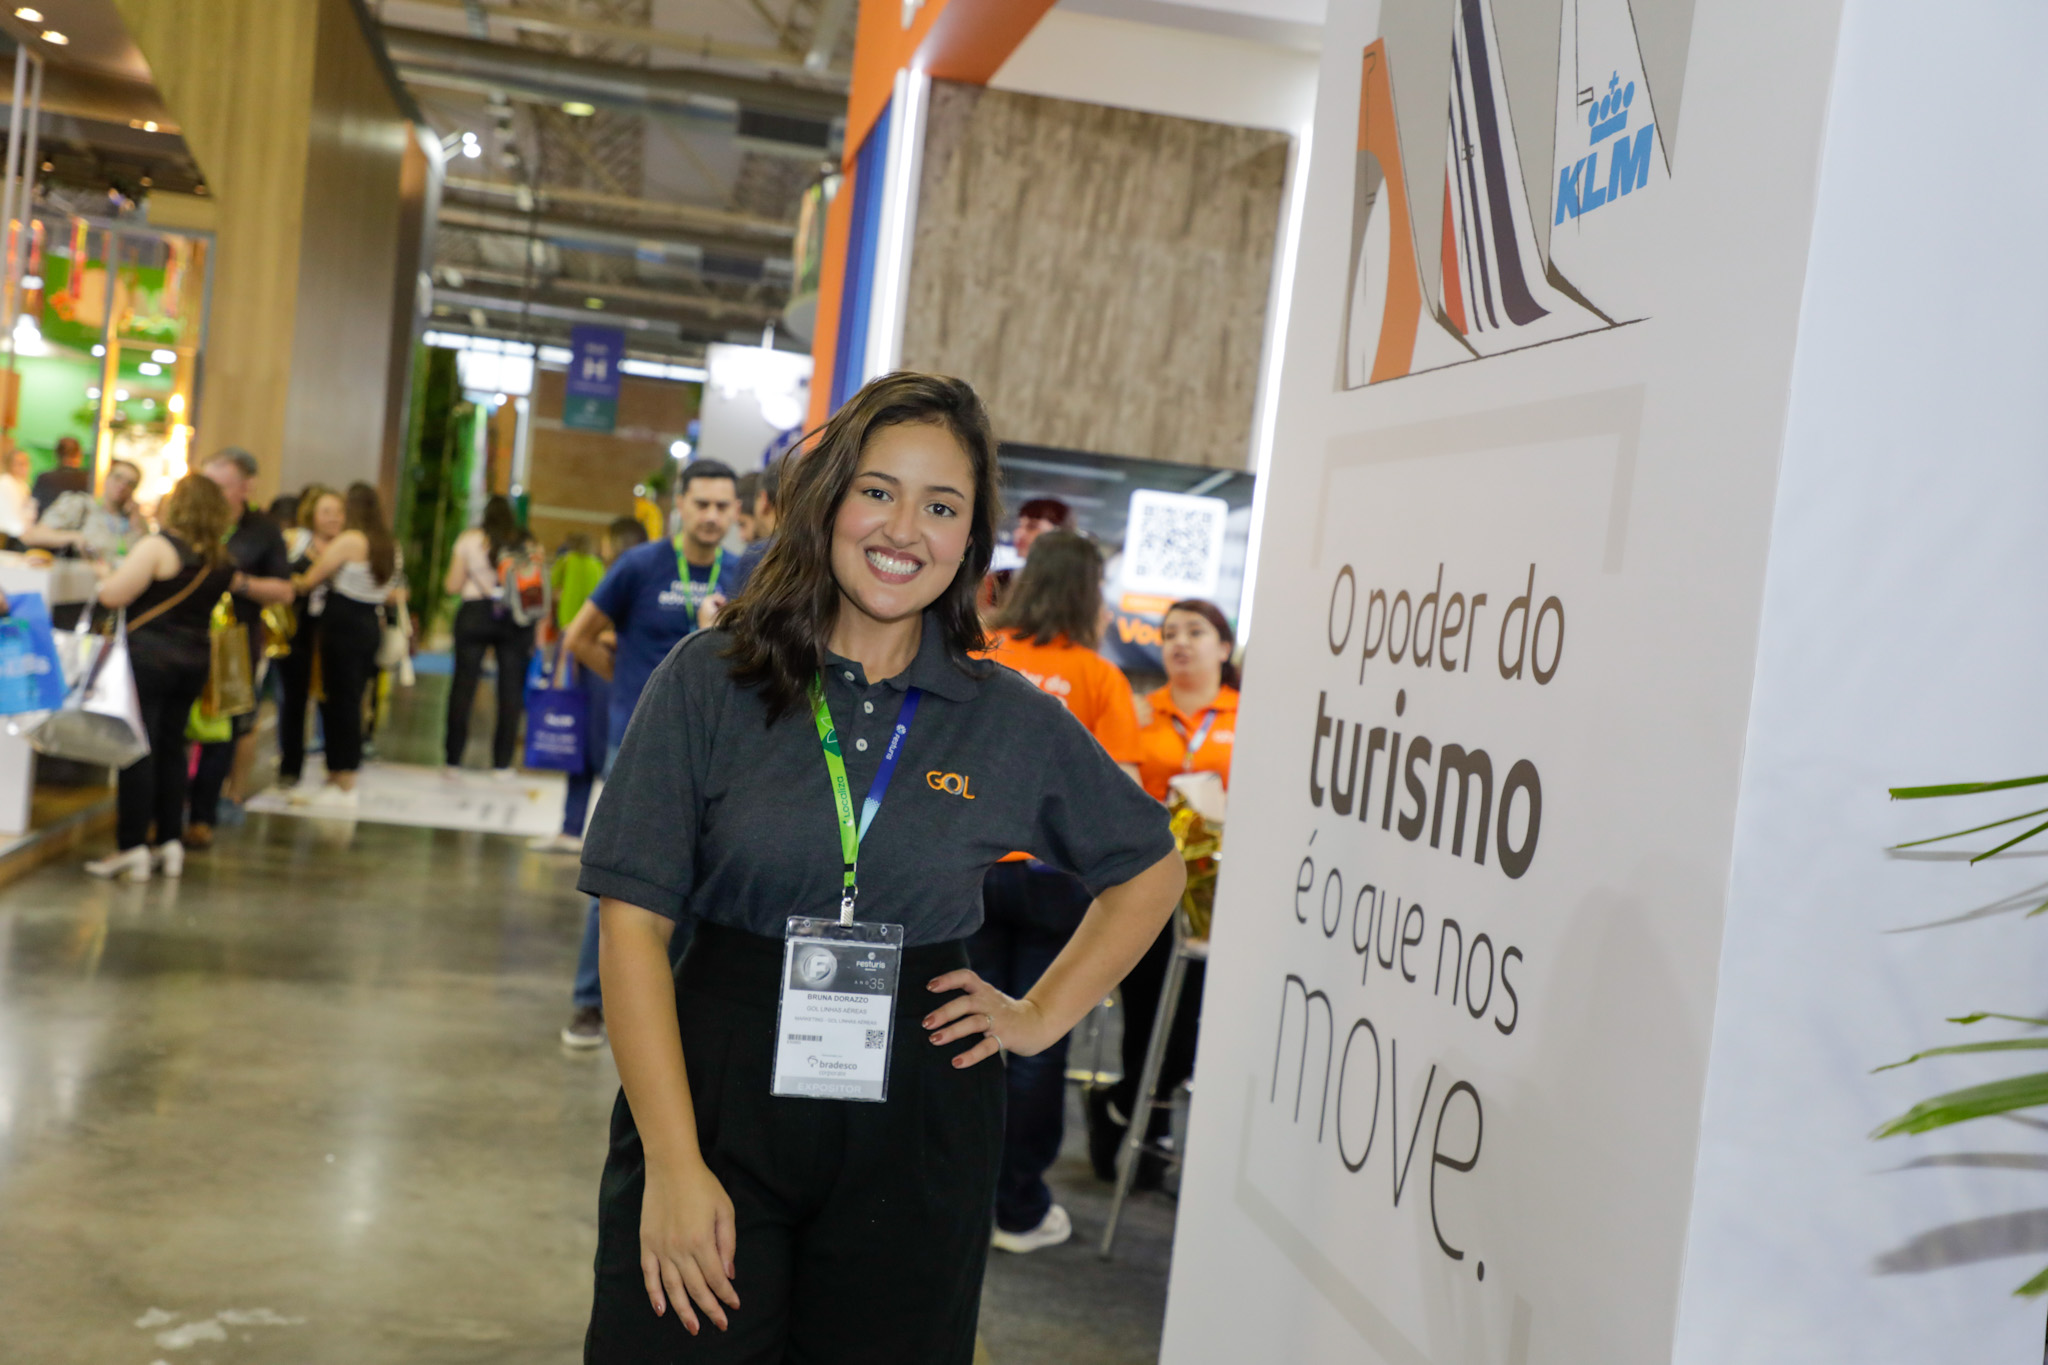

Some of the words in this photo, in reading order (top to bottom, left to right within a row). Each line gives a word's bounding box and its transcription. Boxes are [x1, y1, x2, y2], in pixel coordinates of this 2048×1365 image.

[1554, 123, 1654, 226] KLM
[1328, 563, 1356, 657] O
[1359, 562, 1488, 686] poder
[1498, 562, 1565, 686] do
[836, 776, 850, 818] Localiza
[926, 770, 976, 800] GOL
[1309, 688, 1543, 880] turismo
[1295, 829, 1318, 924] é
[1322, 868, 1343, 938] o
[1352, 884, 1424, 986] que
[1434, 918, 1523, 1035] nos
[807, 993, 832, 1002] BRUNA
[834, 995, 869, 1003] DORAZZO
[869, 977, 885, 990] 35
[819, 1060, 858, 1070] bradesco
[798, 1082, 862, 1094] EXPOSITOR
[1271, 974, 1485, 1282] move.
